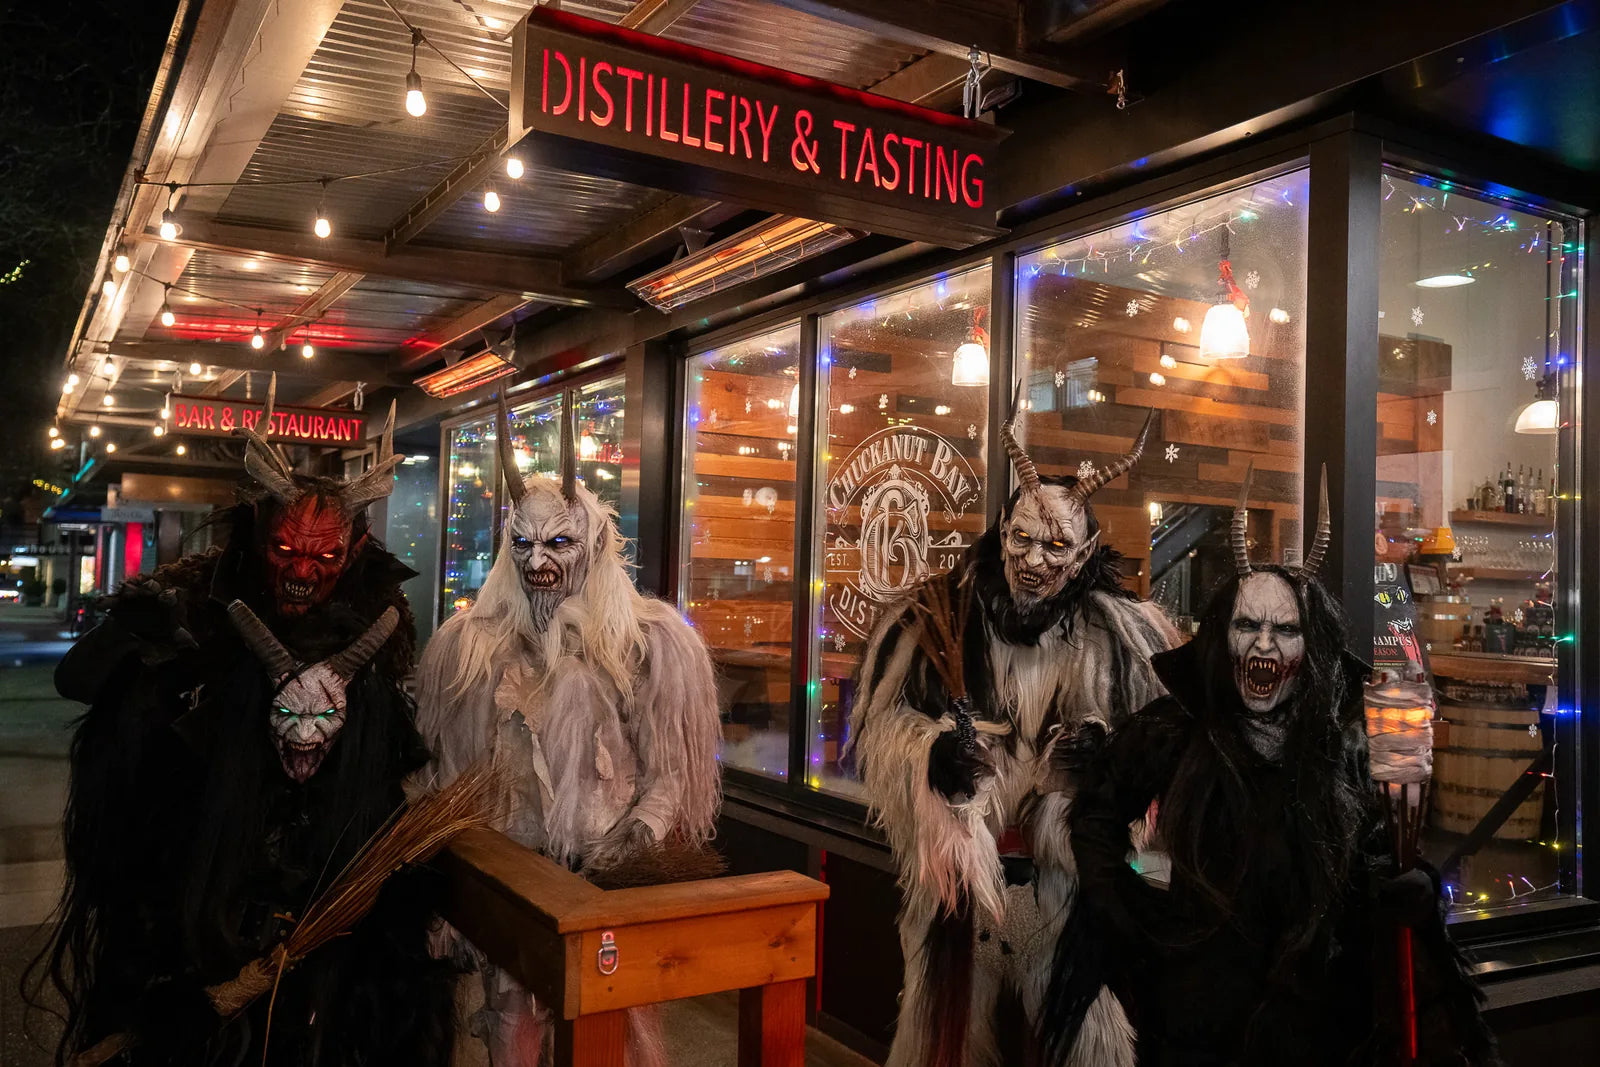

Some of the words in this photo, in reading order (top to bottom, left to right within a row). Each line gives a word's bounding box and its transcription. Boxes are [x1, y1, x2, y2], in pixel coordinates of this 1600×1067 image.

[541, 48, 779, 162] DISTILLERY
[791, 109, 821, 175] &
[833, 119, 985, 209] TASTING
[175, 404, 215, 430] BAR
[220, 406, 235, 432] &
[829, 434, 928, 510] CHUCKANUT
[929, 438, 972, 504] BAY
[830, 553, 850, 567] EST.
